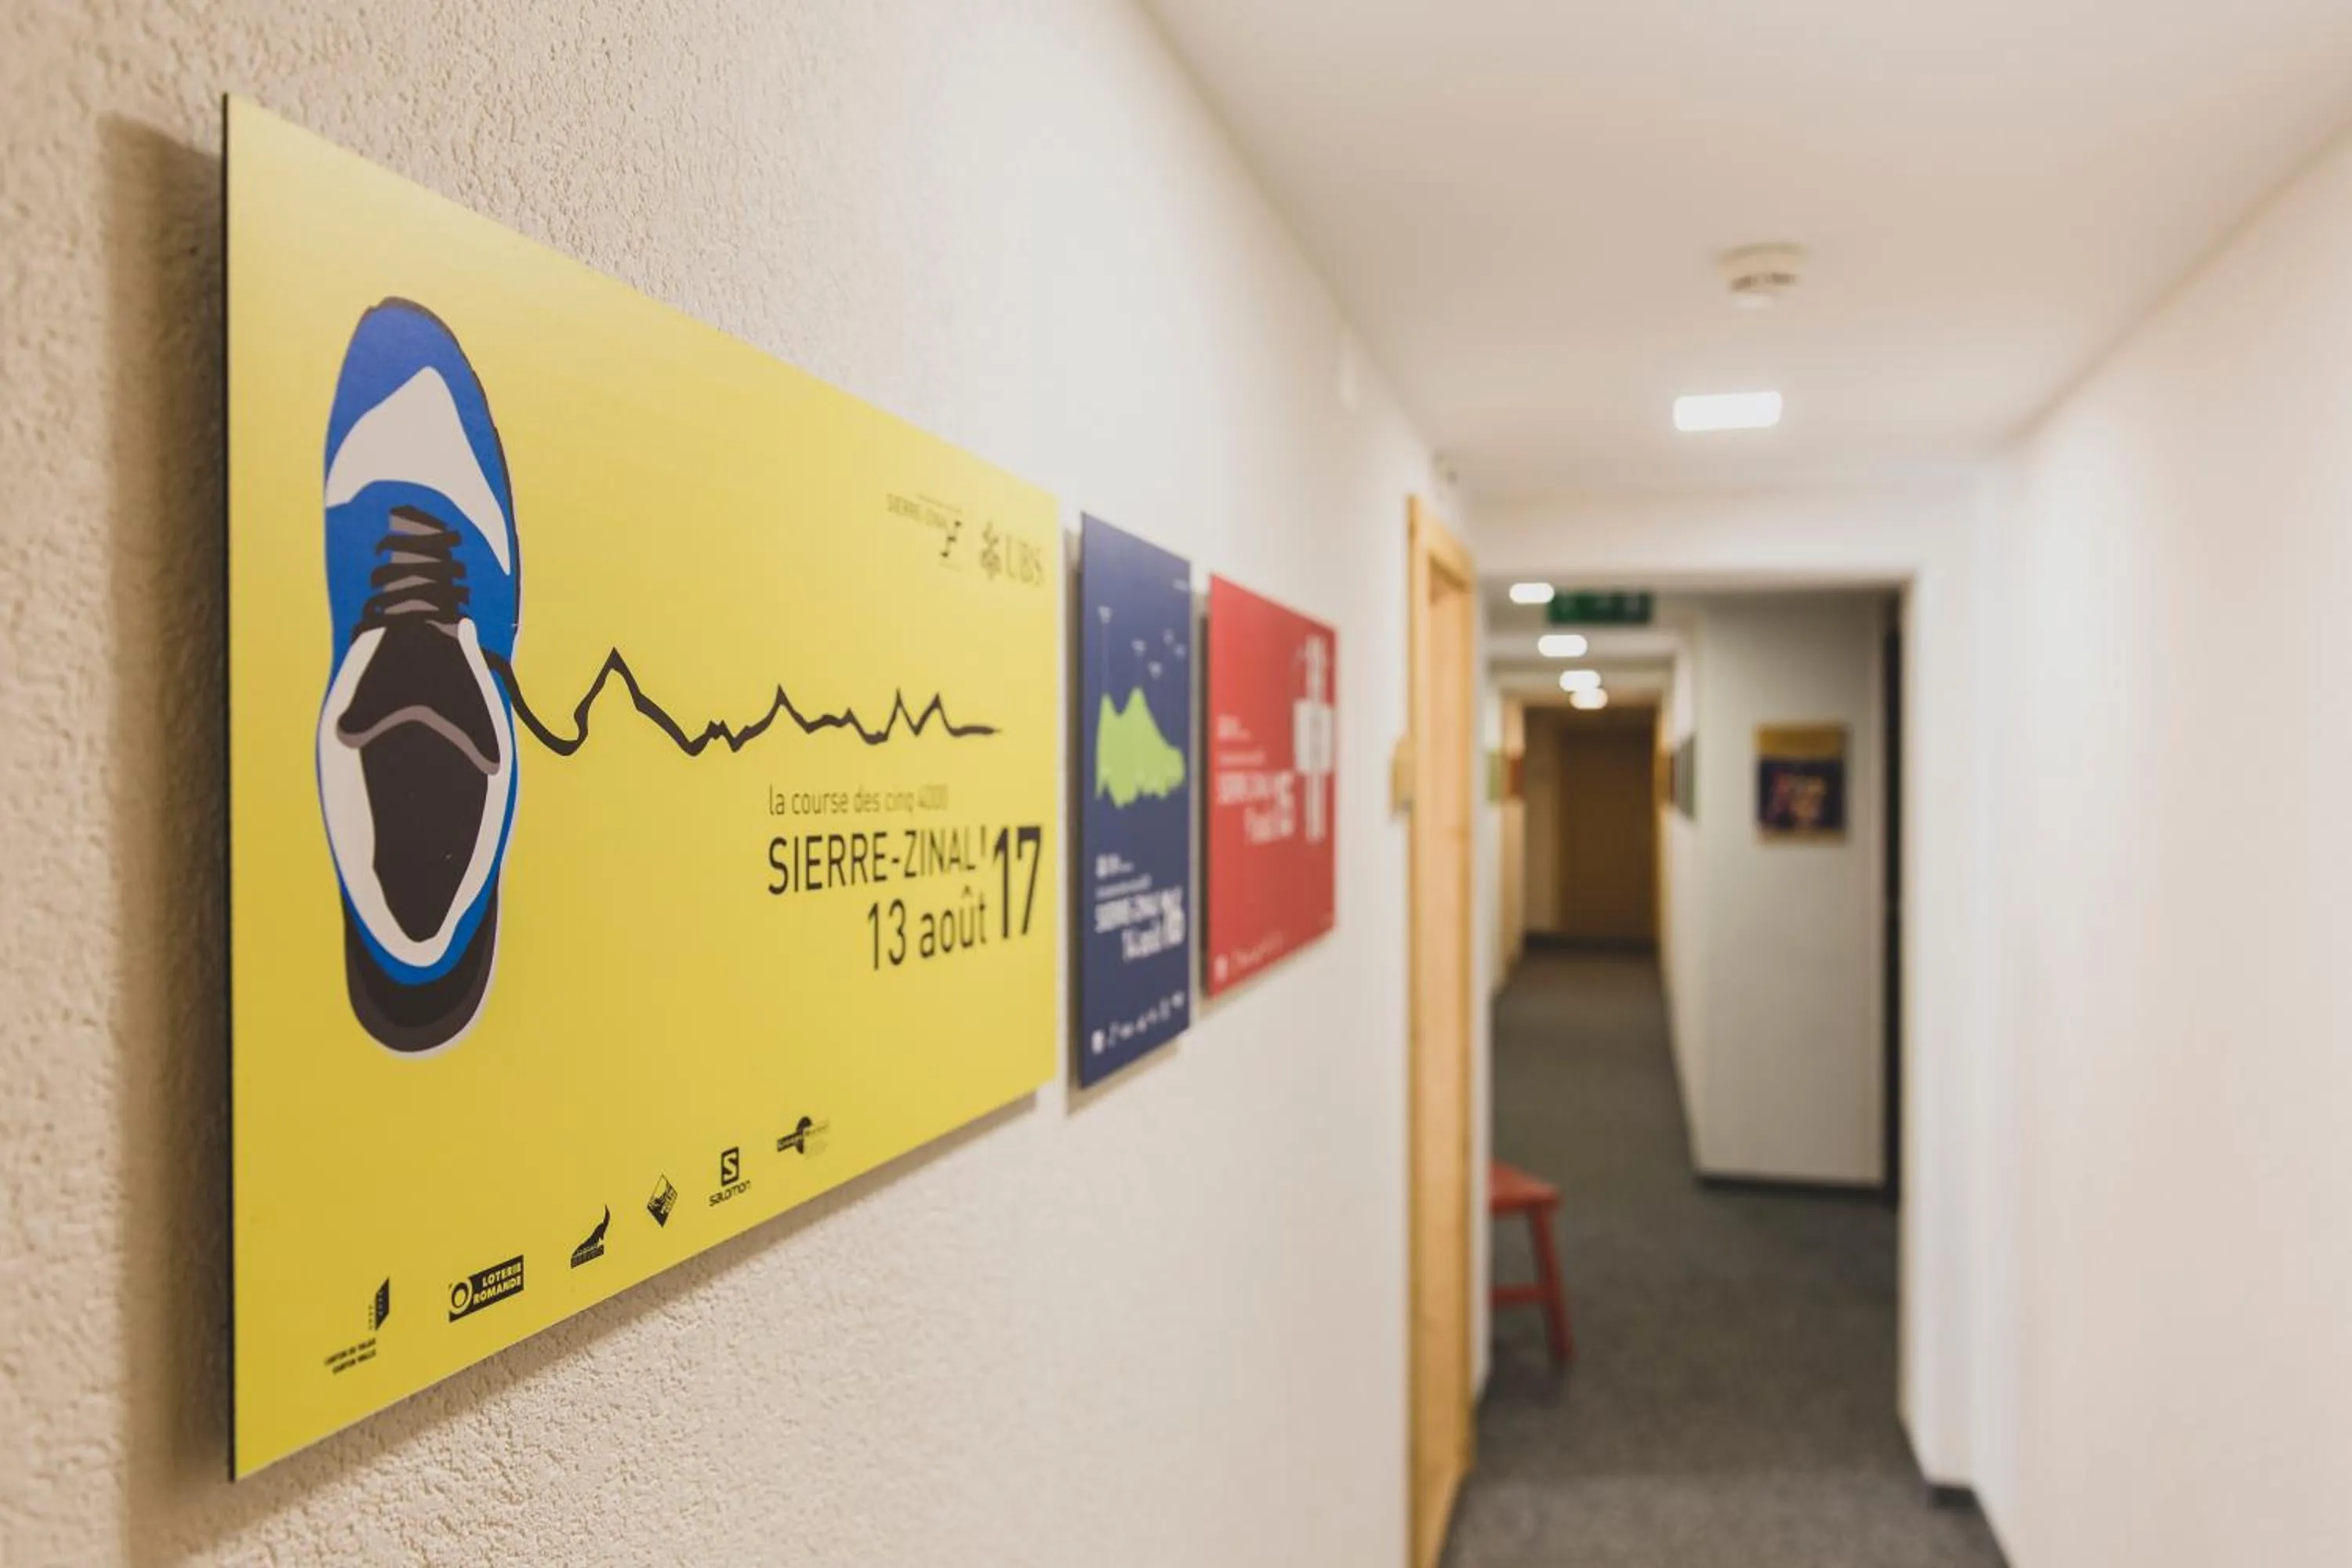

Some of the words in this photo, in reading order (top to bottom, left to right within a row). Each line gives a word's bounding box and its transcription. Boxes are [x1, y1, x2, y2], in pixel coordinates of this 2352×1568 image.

[768, 783, 785, 815] la
[791, 790, 848, 815] course
[854, 784, 880, 813] des
[868, 898, 906, 971] 13
[919, 884, 986, 958] août
[482, 1261, 521, 1287] LOTERIE
[473, 1276, 521, 1305] ROMANDE
